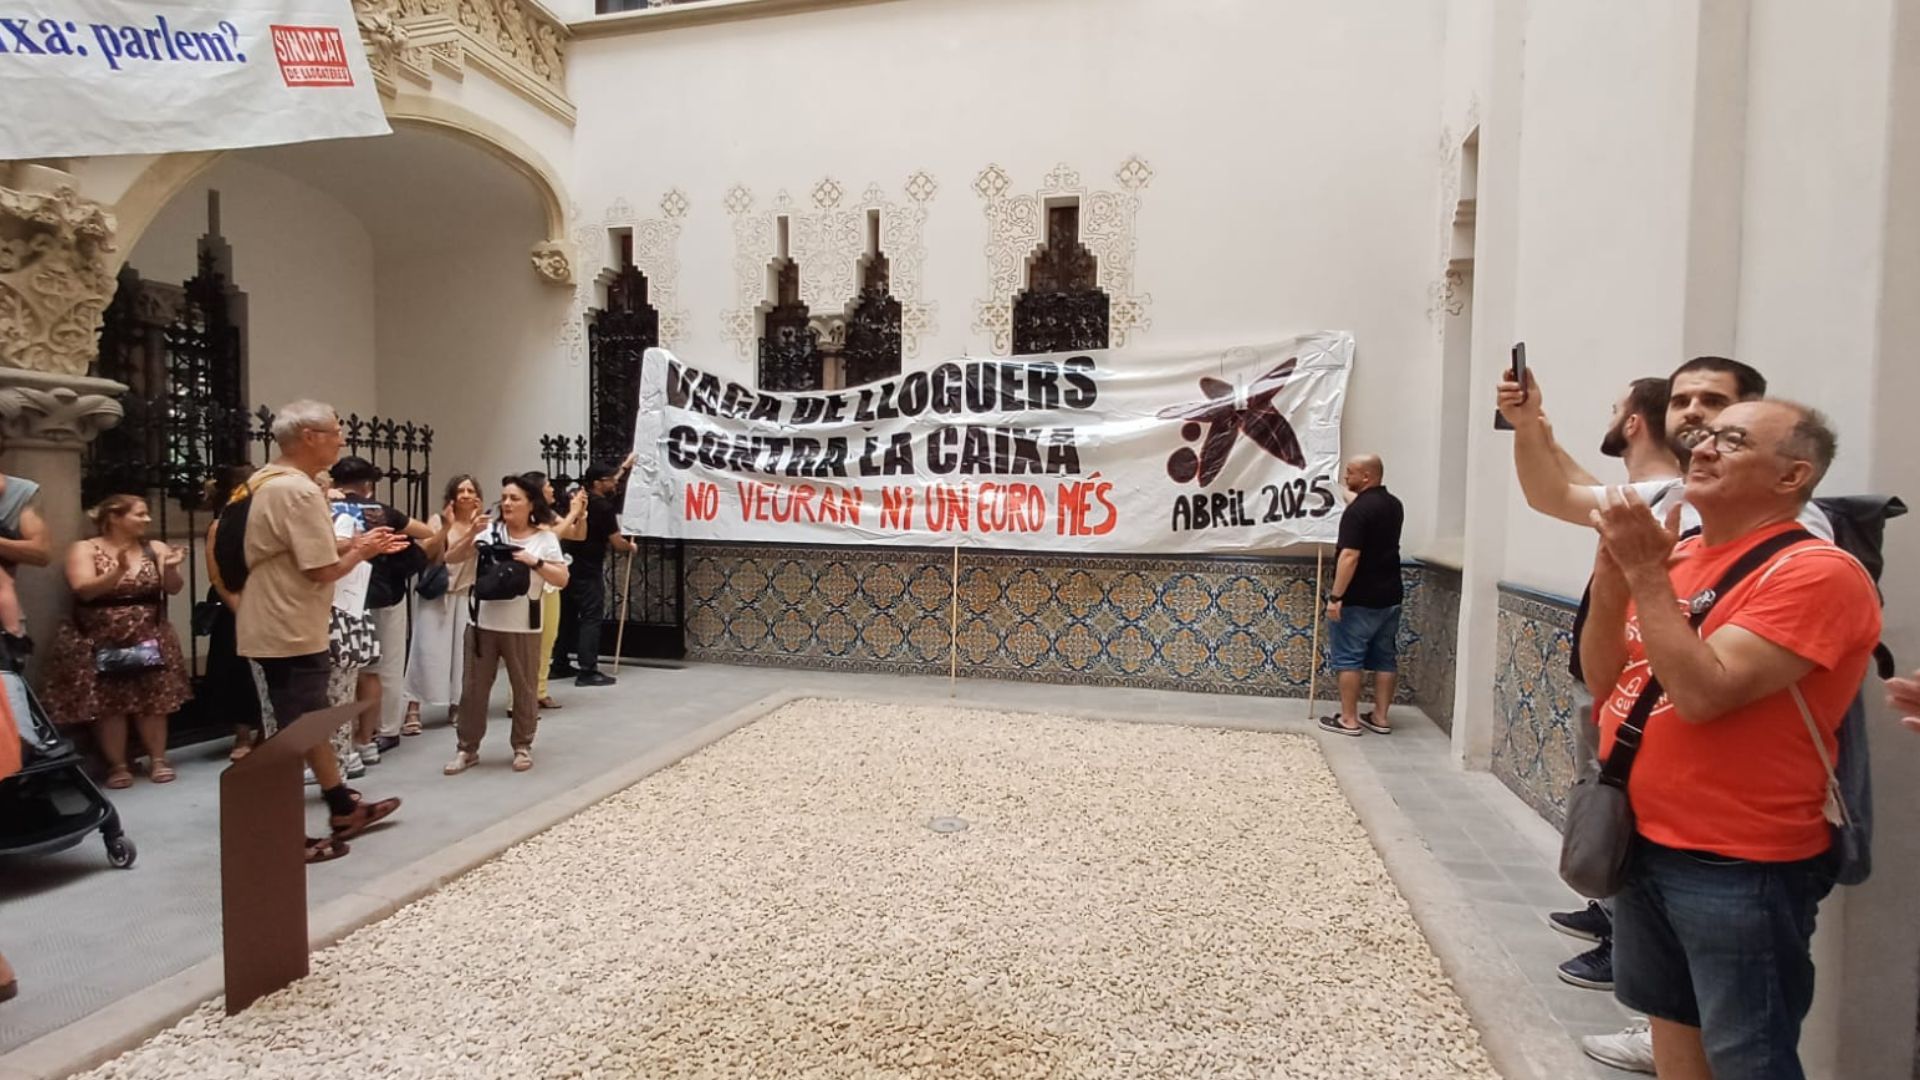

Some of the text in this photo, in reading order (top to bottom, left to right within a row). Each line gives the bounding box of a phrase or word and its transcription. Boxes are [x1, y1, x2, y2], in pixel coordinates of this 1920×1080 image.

[89, 15, 247, 70] parlem?
[274, 29, 343, 63] SINDICAT
[286, 67, 301, 79] DE
[667, 355, 1098, 424] VAGA DE LLOGUERS
[668, 424, 1081, 477] CONTRA LA CAIXA
[685, 481, 720, 521] NO
[737, 481, 863, 526] VEURAN
[925, 482, 969, 532] UN
[976, 482, 1046, 533] EURO
[1056, 471, 1118, 536] MÉS
[1261, 475, 1335, 524] 2025
